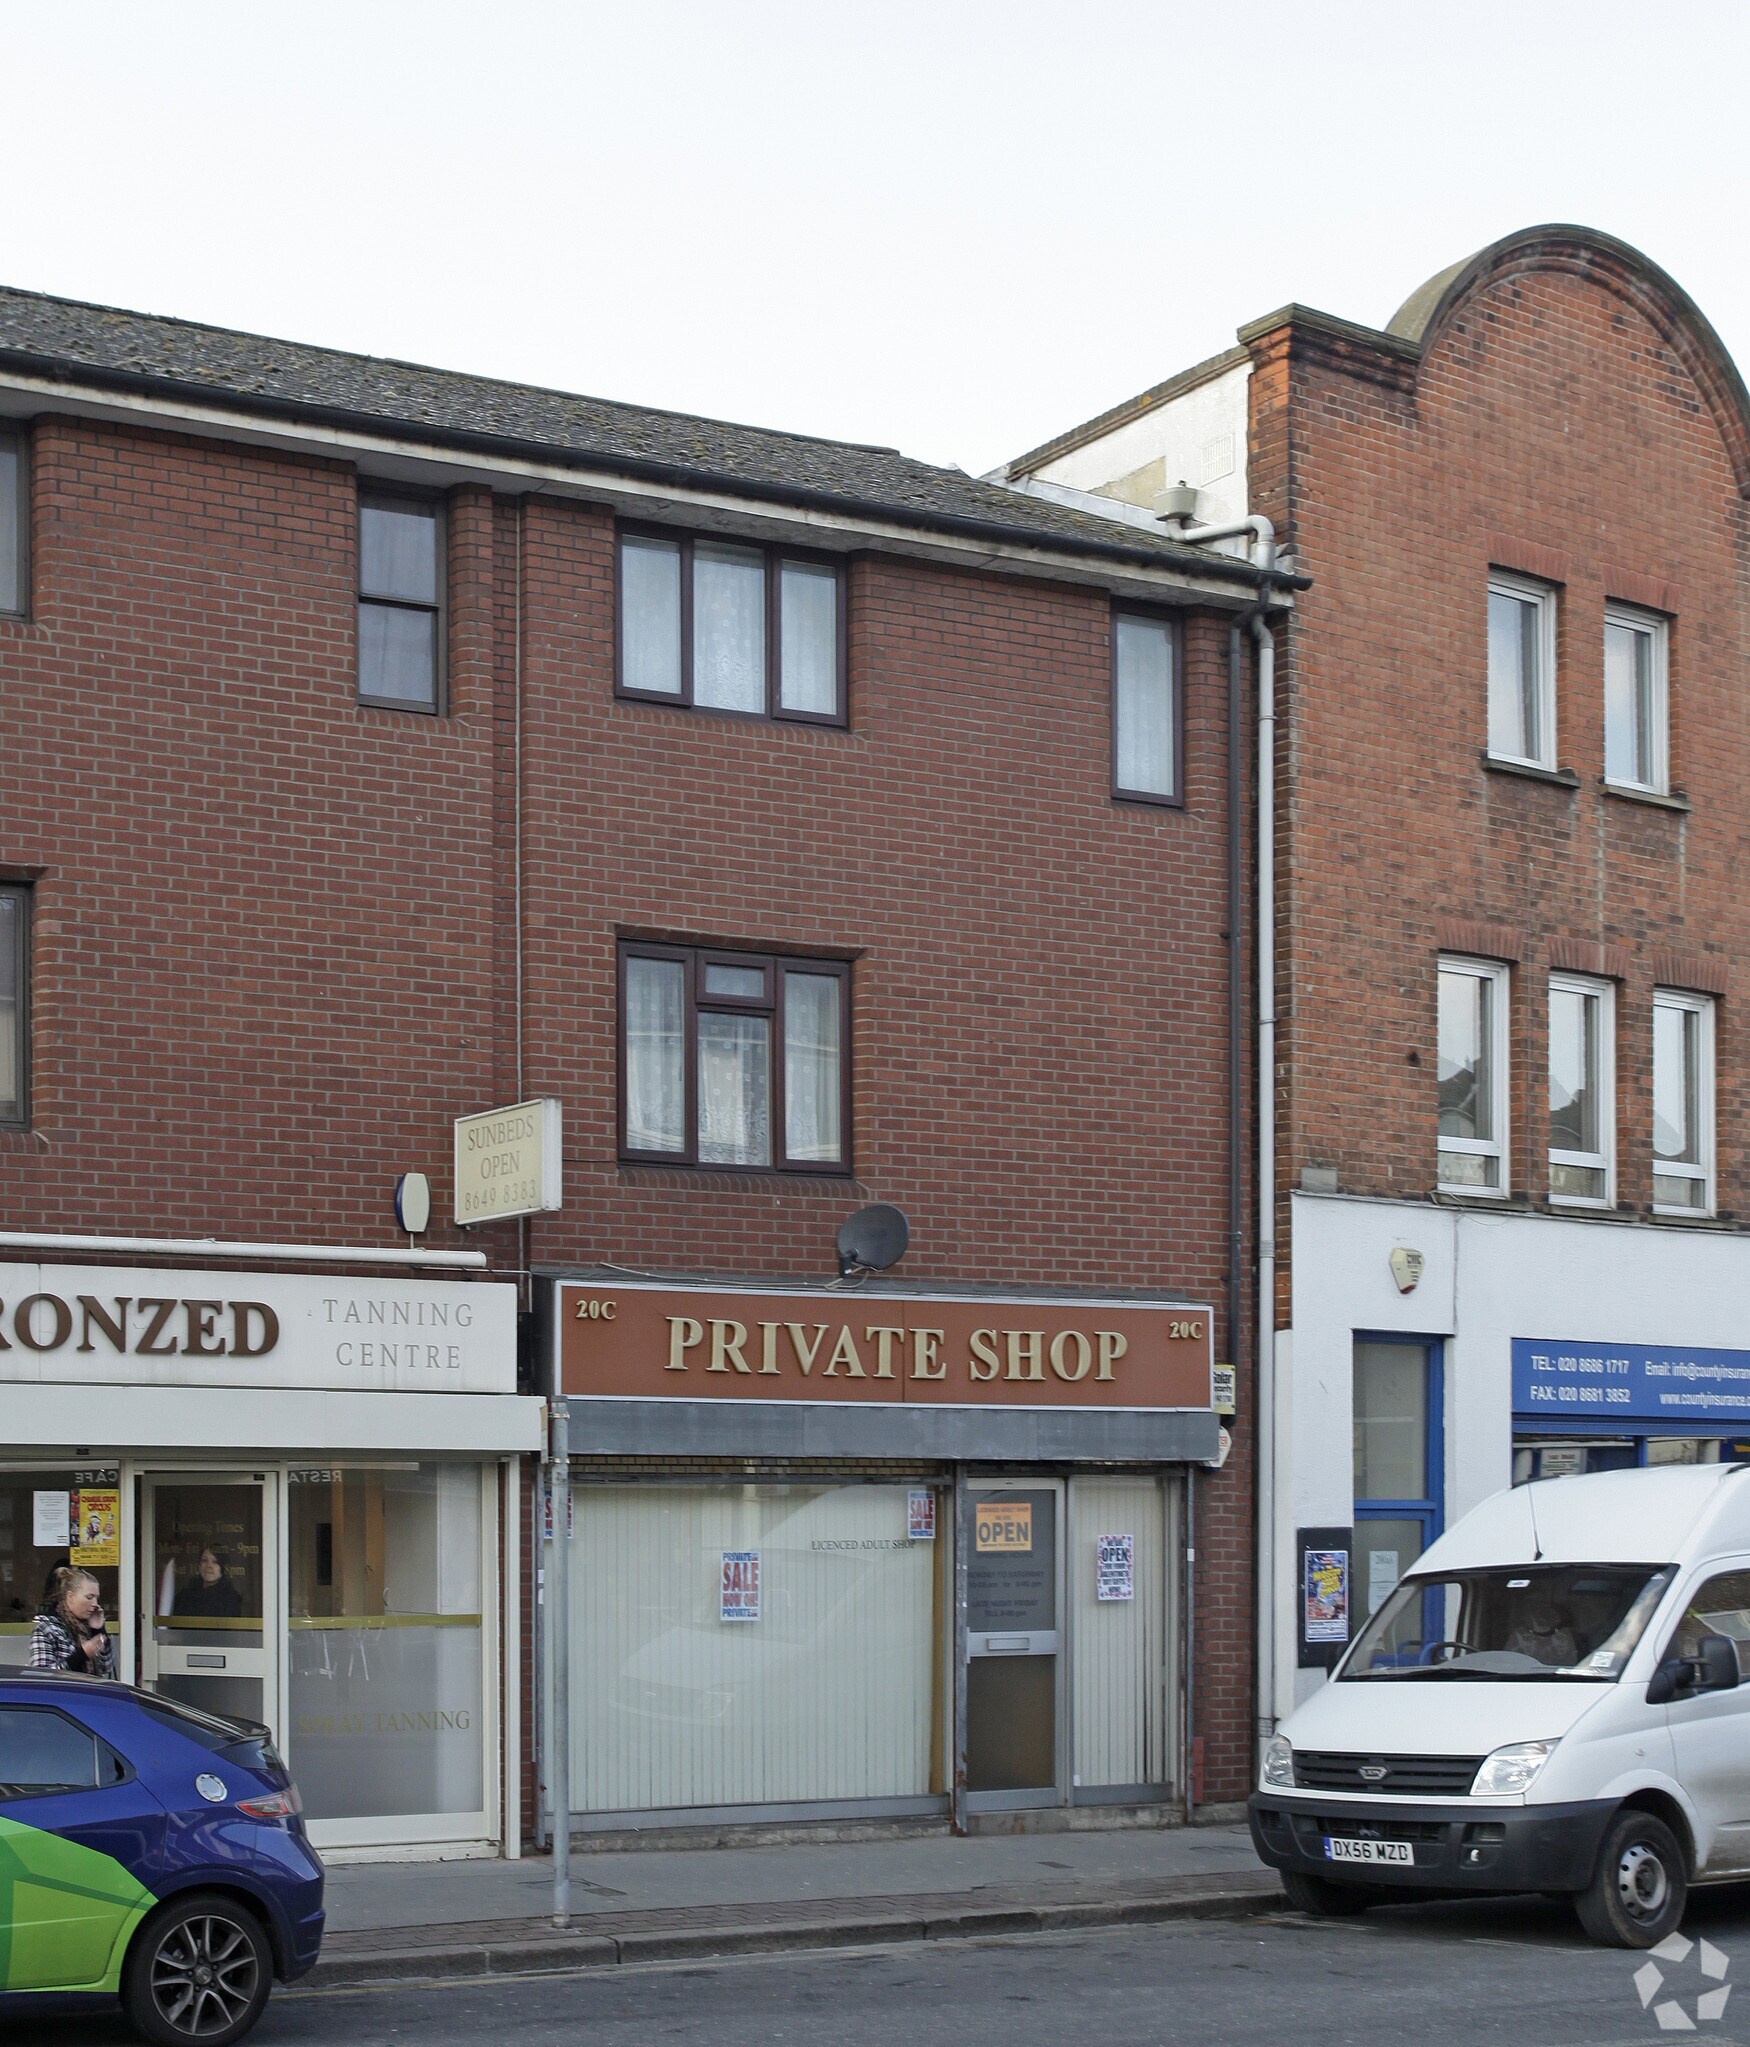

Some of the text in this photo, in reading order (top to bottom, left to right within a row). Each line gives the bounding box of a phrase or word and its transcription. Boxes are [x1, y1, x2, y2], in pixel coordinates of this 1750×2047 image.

[467, 1114, 534, 1151] SUNBEDS
[480, 1150, 521, 1179] OPEN
[464, 1179, 537, 1211] 8649 8383
[323, 1298, 474, 1328] TANNING
[575, 1299, 617, 1320] 20C
[0, 1291, 281, 1357] ONZED
[1169, 1320, 1204, 1340] 20C
[335, 1341, 461, 1369] CENTRE
[663, 1315, 1129, 1382] PRIVATE SHOP
[1531, 1355, 1557, 1372] TEL:
[1557, 1356, 1578, 1373] 020
[1605, 1359, 1631, 1375] 1717
[1530, 1385, 1557, 1401] FAX:
[1557, 1386, 1578, 1402] 020
[978, 1521, 1030, 1543] OPEN
[861, 1539, 891, 1550] ADULT
[1102, 1547, 1129, 1562] OPEN
[723, 1562, 759, 1592] SALE
[376, 1710, 471, 1732] TANNING
[1333, 1840, 1372, 1859] DX56
